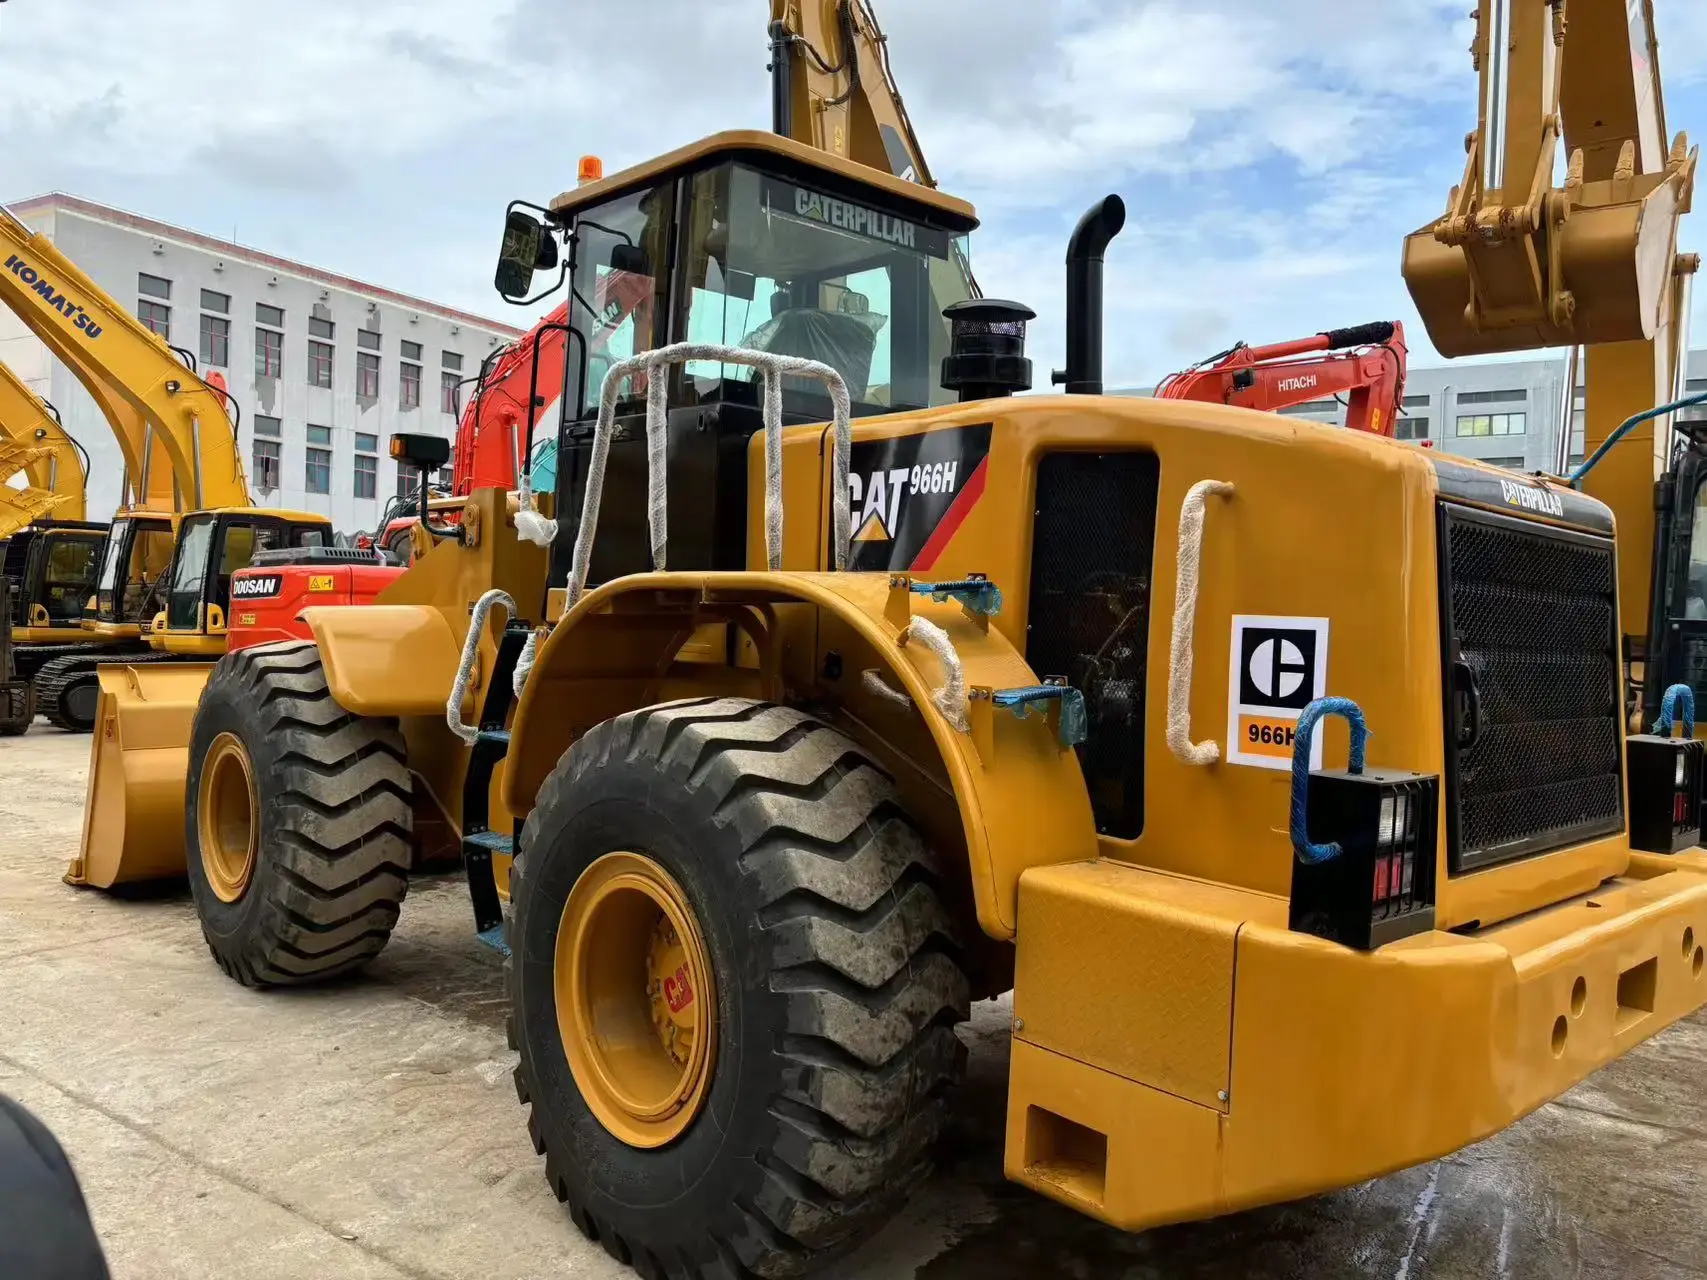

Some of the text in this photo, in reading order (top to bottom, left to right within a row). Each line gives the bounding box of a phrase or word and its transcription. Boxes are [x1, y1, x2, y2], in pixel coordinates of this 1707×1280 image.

[794, 187, 915, 248] CATERPILLAR
[4, 254, 103, 338] KOMATSU
[1277, 374, 1317, 392] HITACHI
[909, 461, 958, 495] 966H
[1500, 479, 1563, 517] CATERPILLAR
[233, 578, 276, 595] DOOSAN
